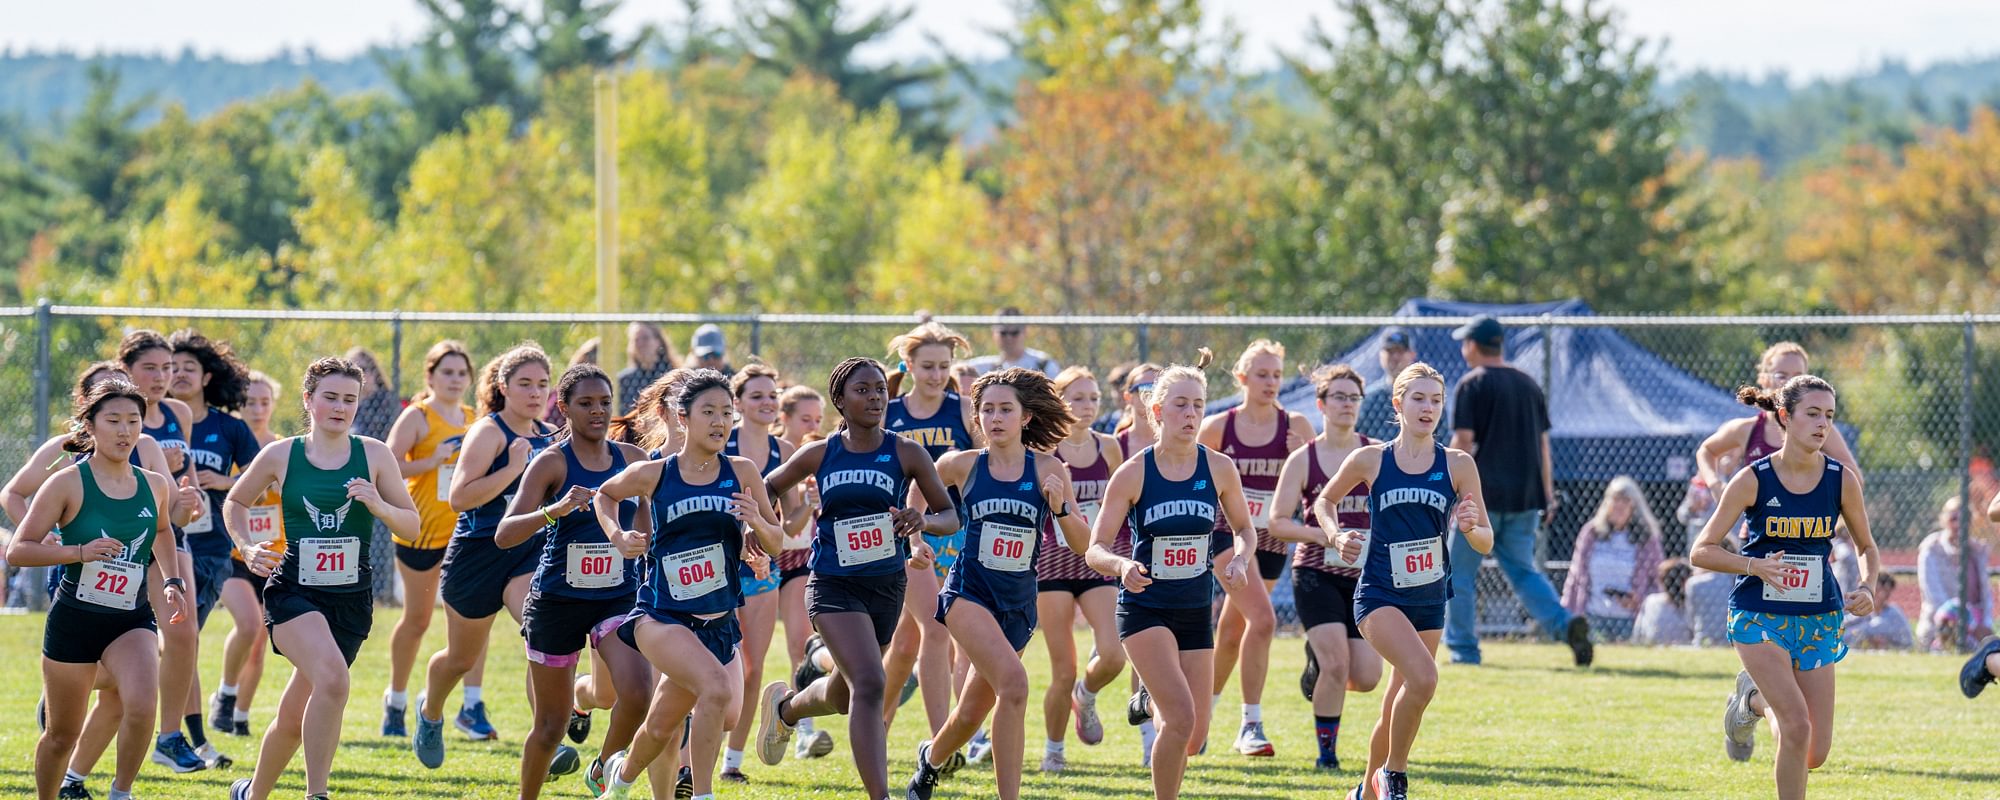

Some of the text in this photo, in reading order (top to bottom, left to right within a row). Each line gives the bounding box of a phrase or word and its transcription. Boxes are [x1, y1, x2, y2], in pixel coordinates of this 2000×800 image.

[822, 469, 895, 496] ANDOVER
[971, 498, 1038, 525] ANDOVER
[1143, 499, 1215, 526] ANDOVER
[1380, 487, 1447, 514] ANDOVER
[847, 527, 883, 551] 599
[1765, 516, 1832, 539] CONVAL
[992, 537, 1024, 559] 610
[1163, 547, 1197, 567] 596
[316, 552, 345, 571] 211
[581, 556, 613, 575] 607
[678, 560, 715, 586] 604
[1405, 552, 1433, 573] 614
[95, 570, 128, 595] 212
